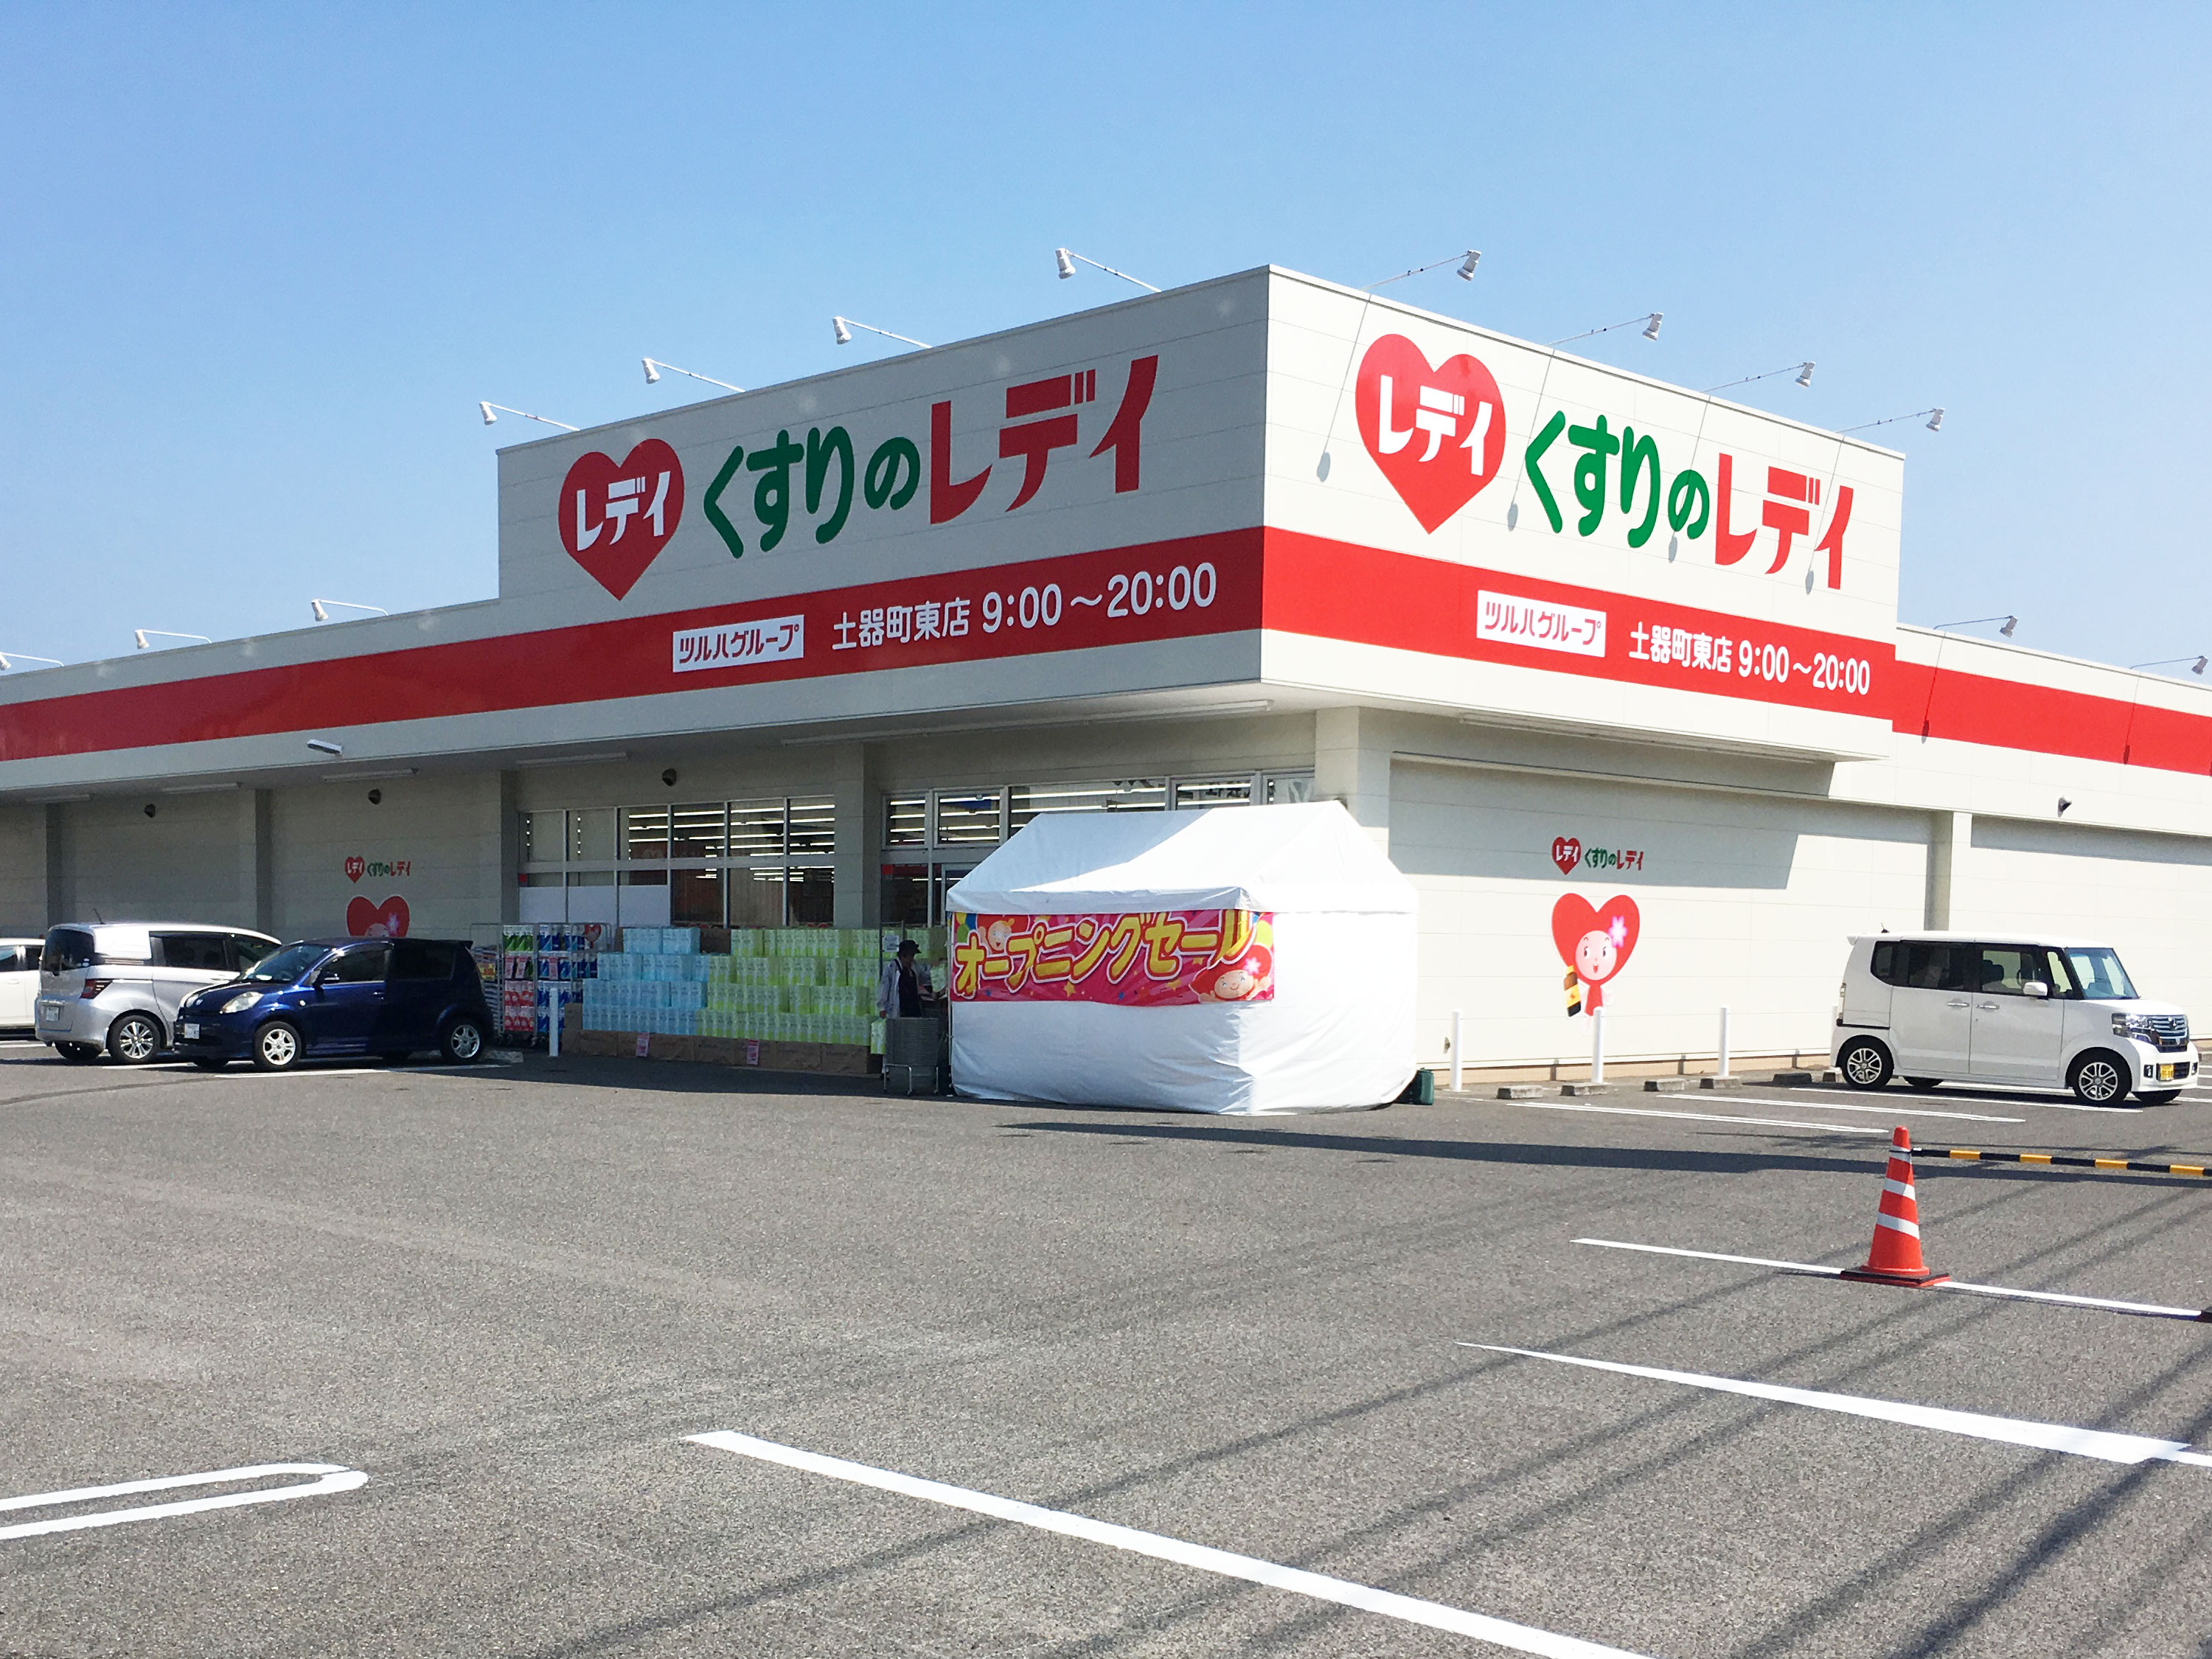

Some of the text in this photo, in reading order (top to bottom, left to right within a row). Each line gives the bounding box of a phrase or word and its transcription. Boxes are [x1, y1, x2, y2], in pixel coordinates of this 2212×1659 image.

[679, 625, 799, 664] ツルハグループ
[832, 597, 970, 650] 土器町東店
[1484, 601, 1601, 645] ツルハグループ
[1629, 621, 1733, 673] 土器町東店
[954, 909, 1255, 998] オープニングセール
